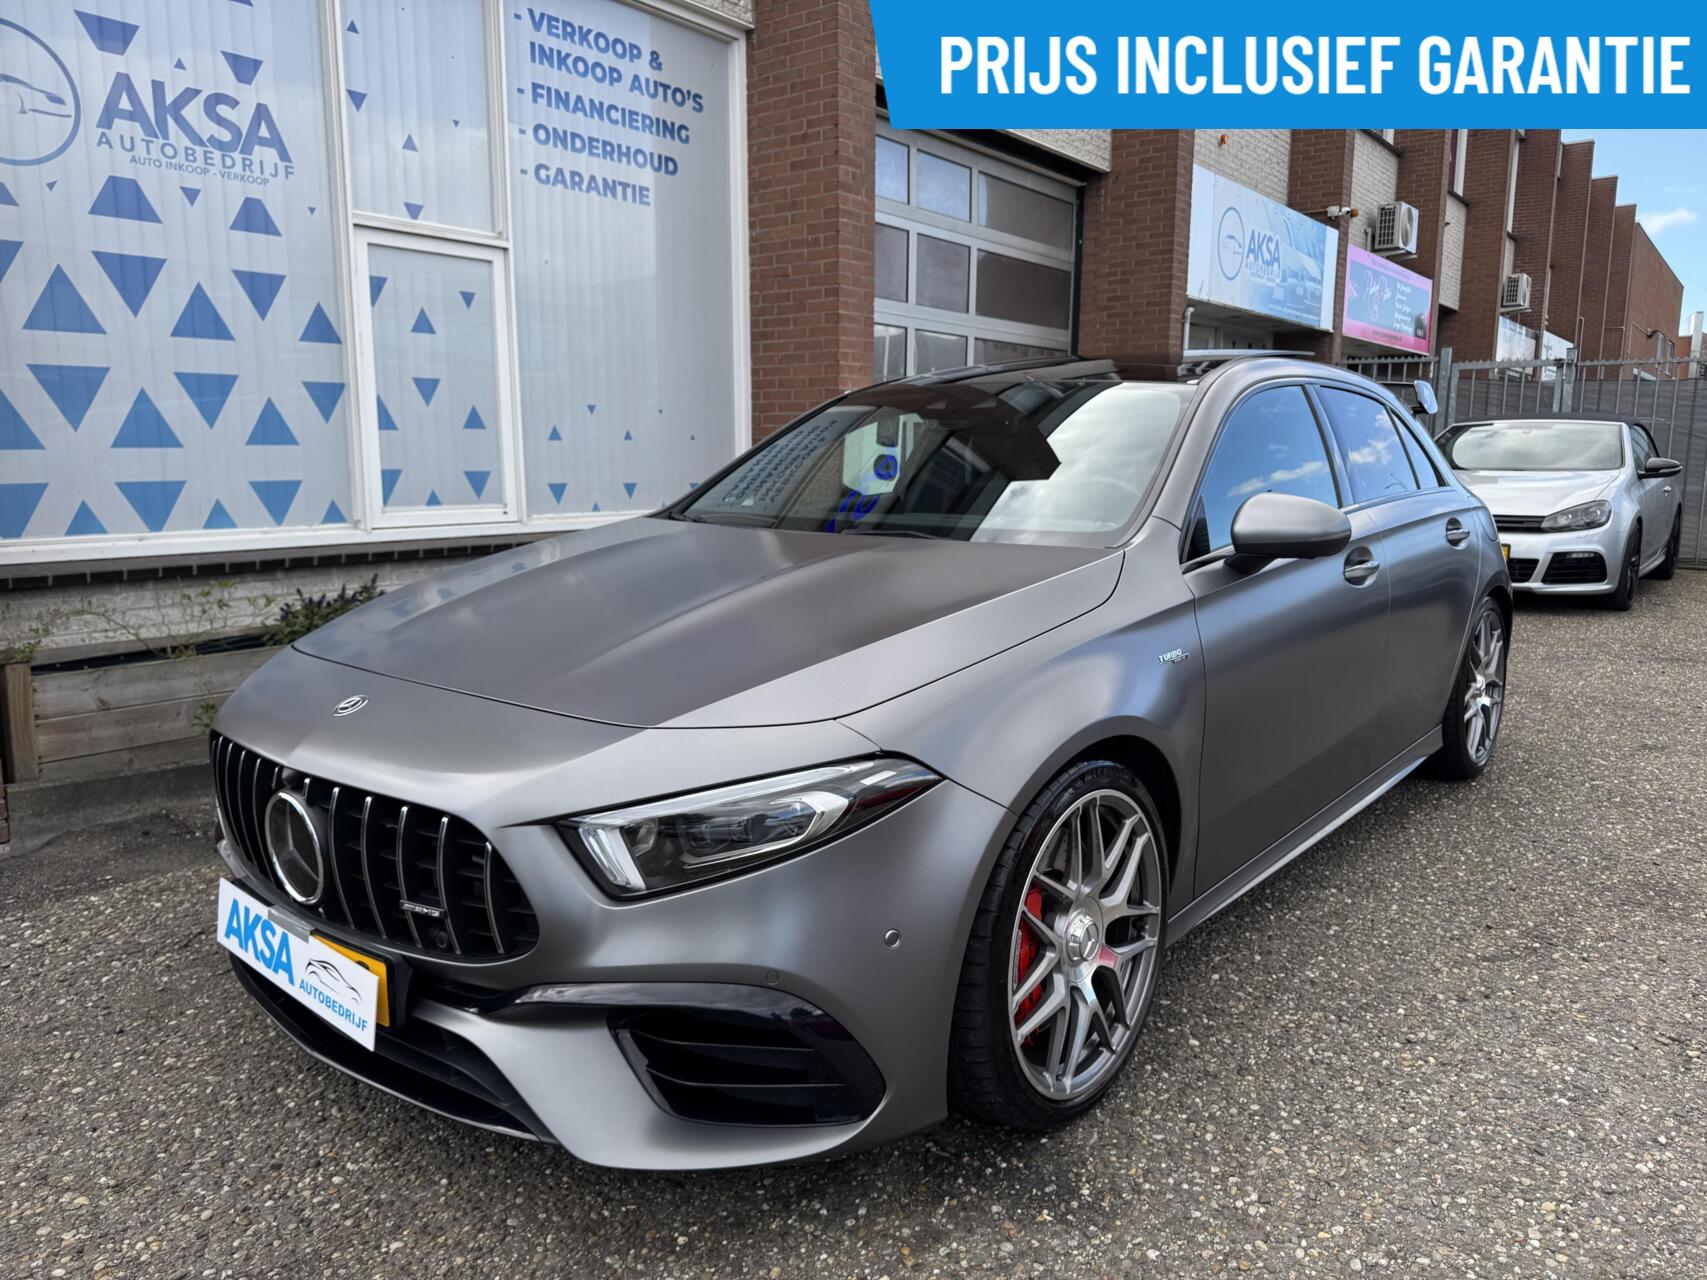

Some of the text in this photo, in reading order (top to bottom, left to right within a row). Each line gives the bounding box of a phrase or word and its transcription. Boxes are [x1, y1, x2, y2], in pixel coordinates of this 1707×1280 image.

[528, 8, 642, 63] VERKOOP
[649, 50, 662, 71] &
[530, 41, 703, 113] INKOOP AUTO'S
[96, 72, 293, 164] AKSA
[531, 82, 690, 144] FINANCIERING
[96, 131, 295, 180] AUTOBEDRIJF
[130, 155, 162, 169] AUTO
[165, 160, 210, 176] INKOOP
[219, 170, 270, 186] VERKOOP
[533, 123, 678, 176] ONDERHOUD
[534, 163, 651, 206] GARANTIE
[1246, 229, 1281, 270] AKSA
[1158, 648, 1182, 665] TURBO
[224, 898, 295, 986] AKSA
[299, 979, 368, 1032] AUTOBEDRIJF
